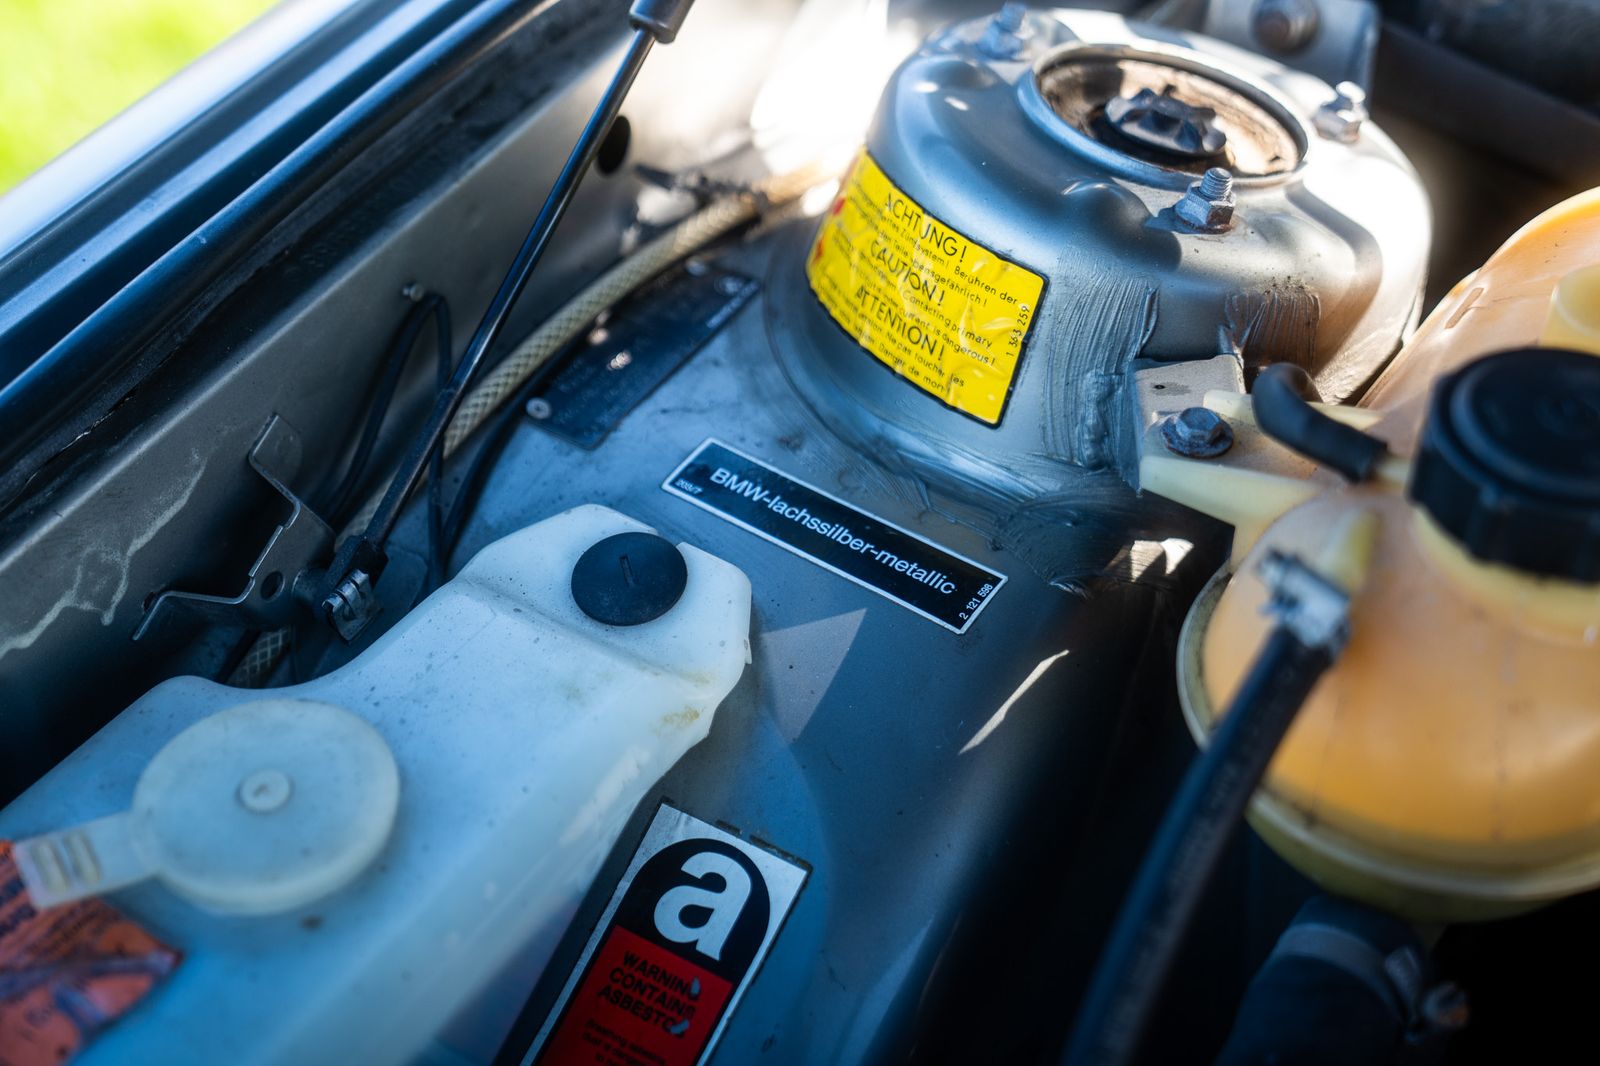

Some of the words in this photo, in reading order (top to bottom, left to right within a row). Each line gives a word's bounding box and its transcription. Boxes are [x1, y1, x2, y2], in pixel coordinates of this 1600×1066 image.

[954, 265, 997, 296] Berühren
[999, 291, 1018, 306] der
[1017, 305, 1030, 326] 259
[709, 467, 956, 594] BMW-lachssilber-metallic
[958, 612, 969, 620] 2
[966, 597, 981, 611] 121
[977, 583, 993, 598] 598
[597, 984, 686, 1038] ASBESTO
